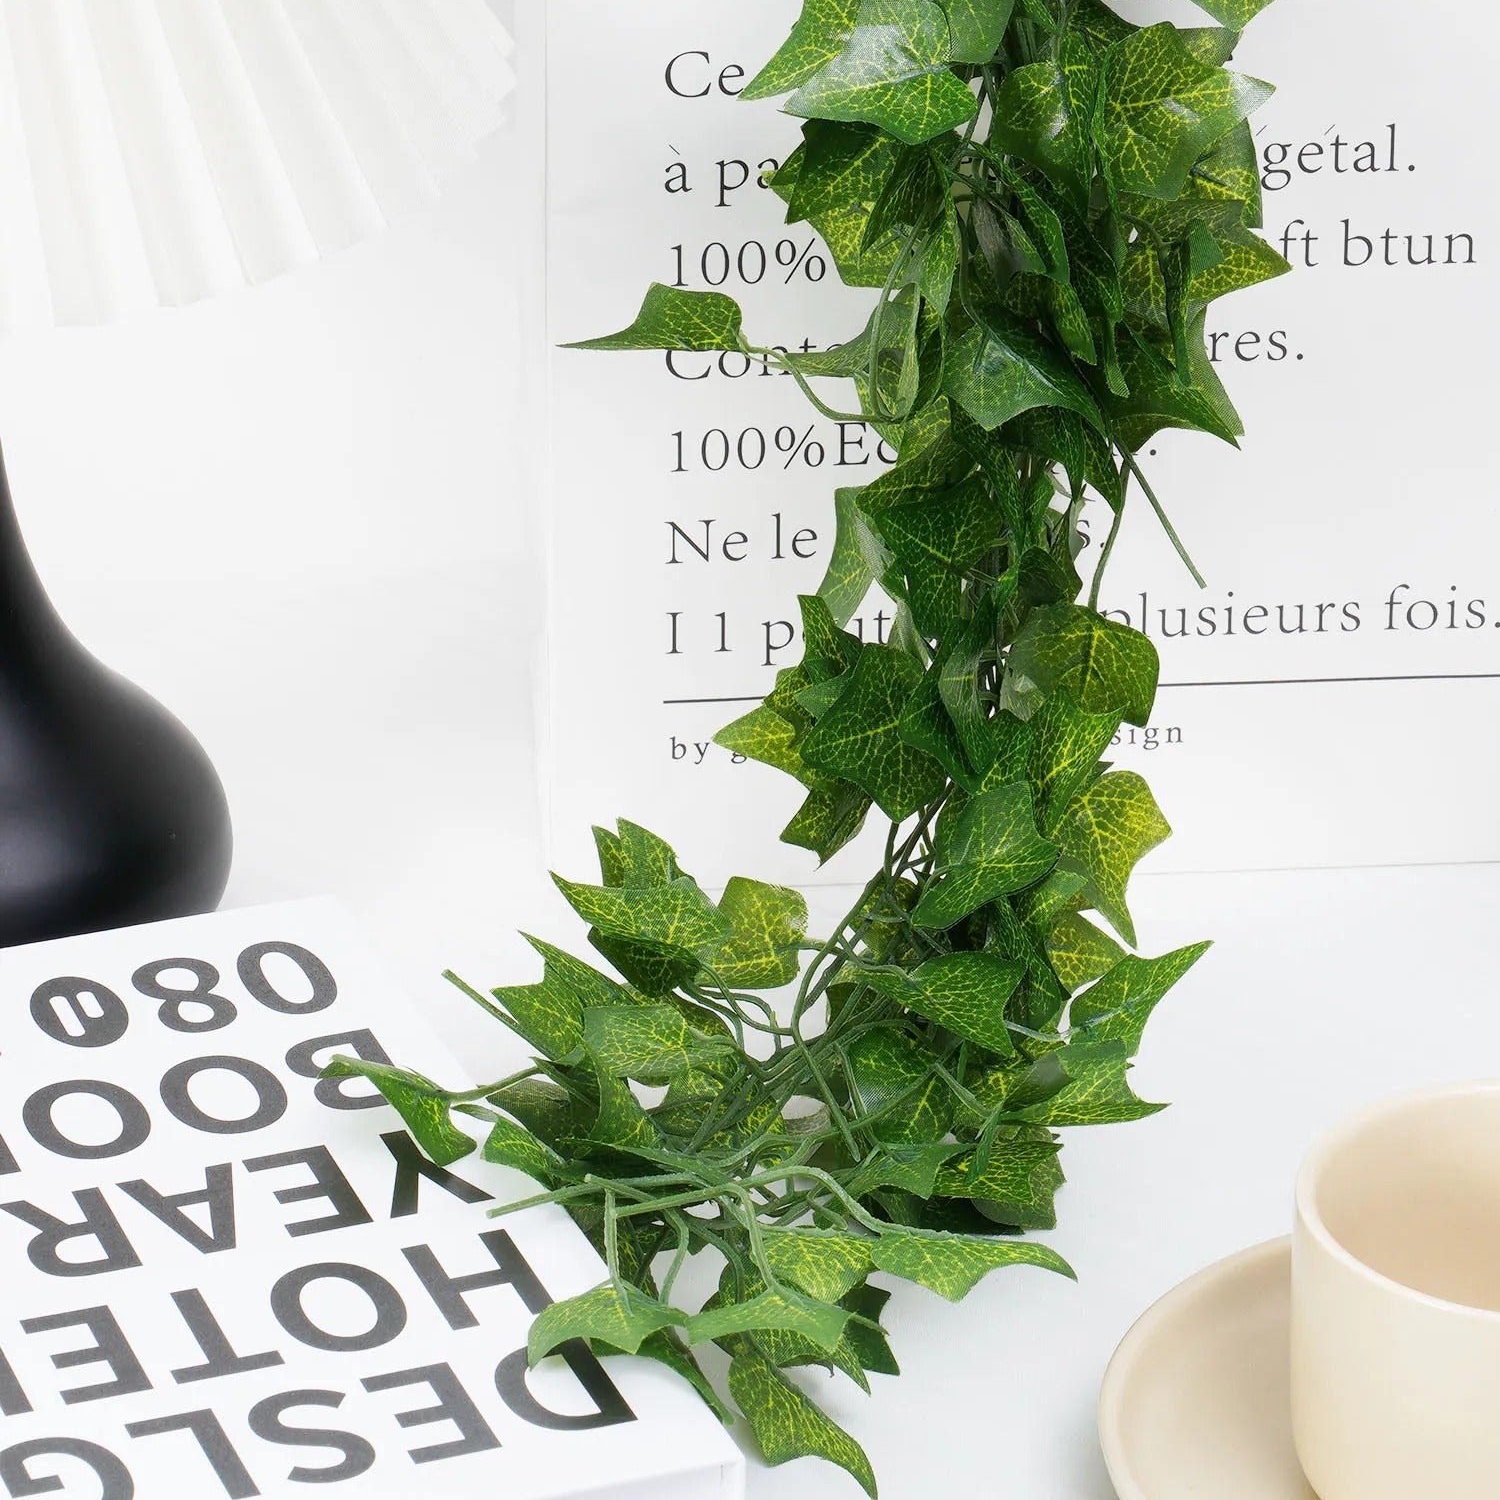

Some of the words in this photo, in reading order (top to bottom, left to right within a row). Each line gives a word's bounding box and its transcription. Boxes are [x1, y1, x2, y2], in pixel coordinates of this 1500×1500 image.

[664, 50, 745, 98] Ce
[664, 144, 693, 194] à
[1256, 122, 1416, 191] gétal.
[670, 237, 826, 287] 100%
[1340, 218, 1477, 266] btun
[664, 518, 749, 565] Ne
[771, 512, 818, 560] le
[665, 611, 684, 655] I
[669, 735, 710, 765] by
[0, 1028, 402, 1177] BOO
[0, 1130, 496, 1277] YEAR
